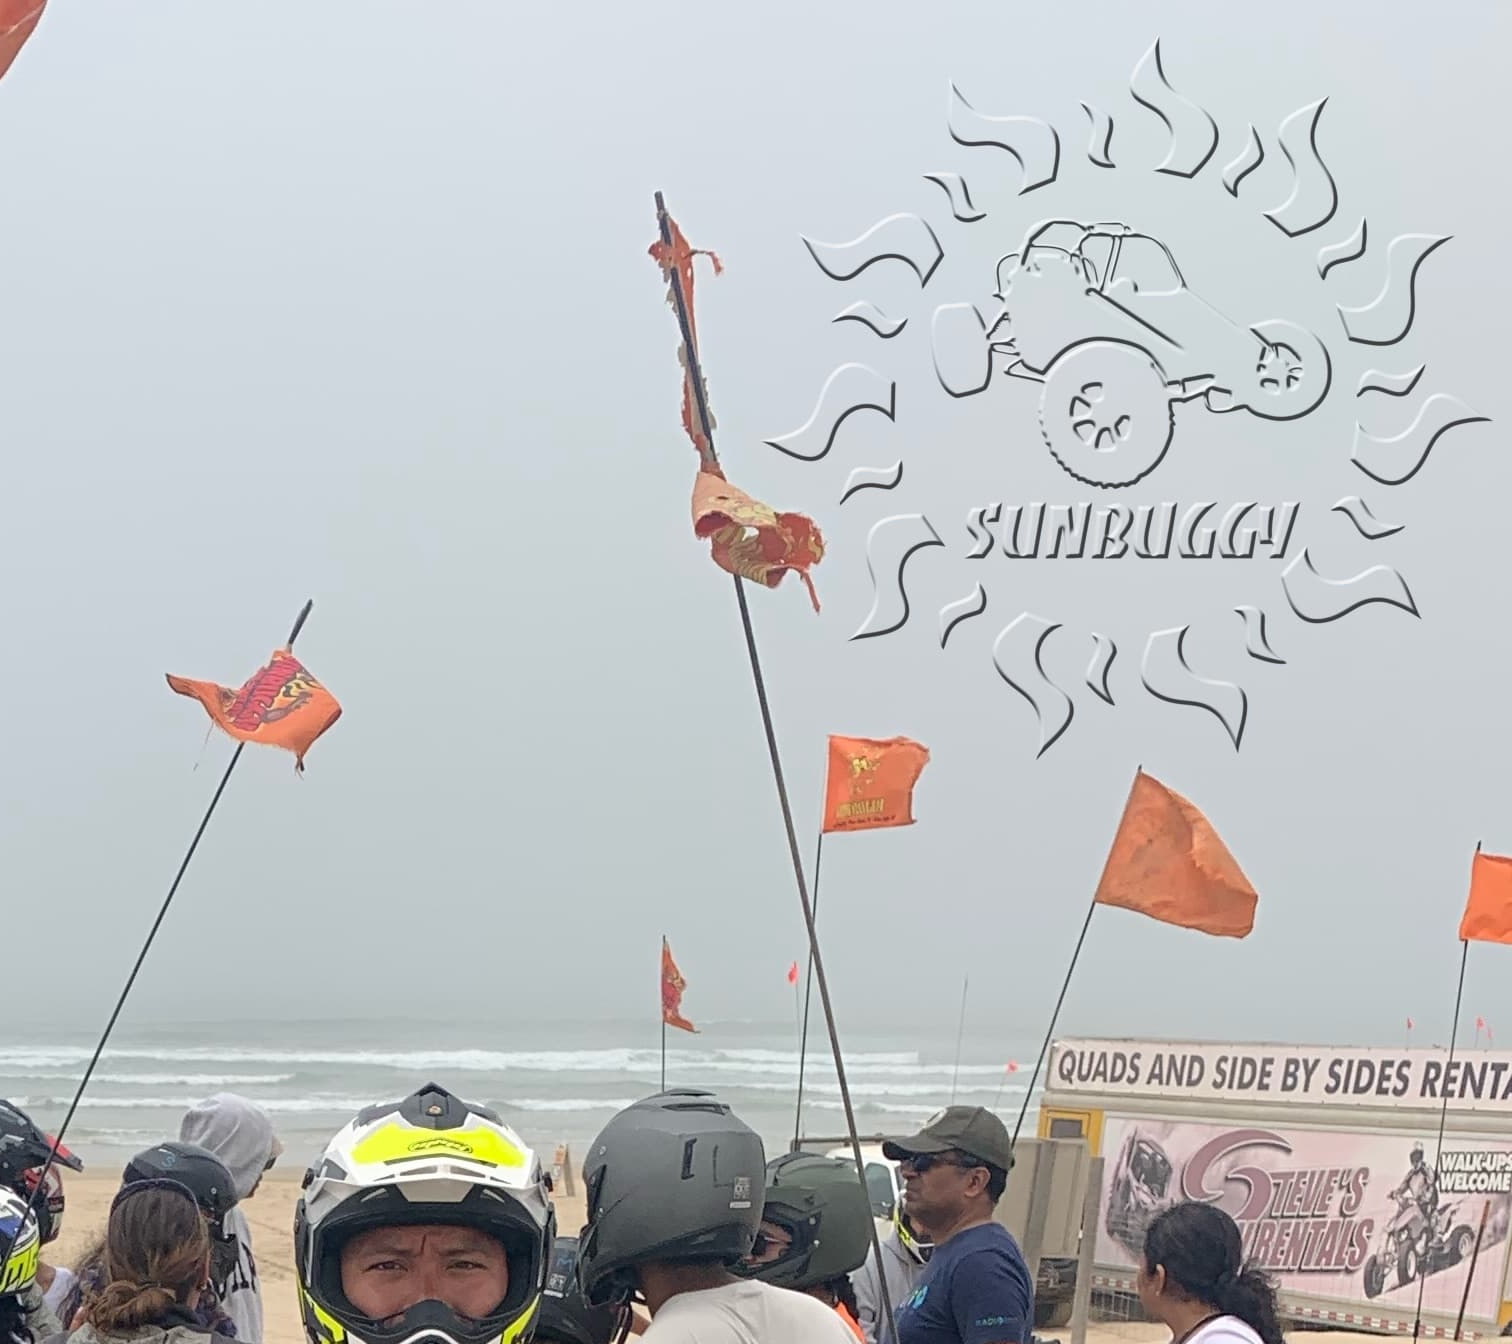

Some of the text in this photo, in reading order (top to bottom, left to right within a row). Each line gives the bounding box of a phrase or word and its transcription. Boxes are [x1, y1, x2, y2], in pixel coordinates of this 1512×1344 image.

[1058, 1049, 1141, 1084] QUADS
[1146, 1053, 1205, 1087] AND
[1212, 1055, 1275, 1091] SIDE
[1280, 1057, 1320, 1093] BY
[1324, 1058, 1412, 1097] SIDES
[1439, 1172, 1511, 1193] WELCOME
[1253, 1218, 1375, 1271] RENTALS
